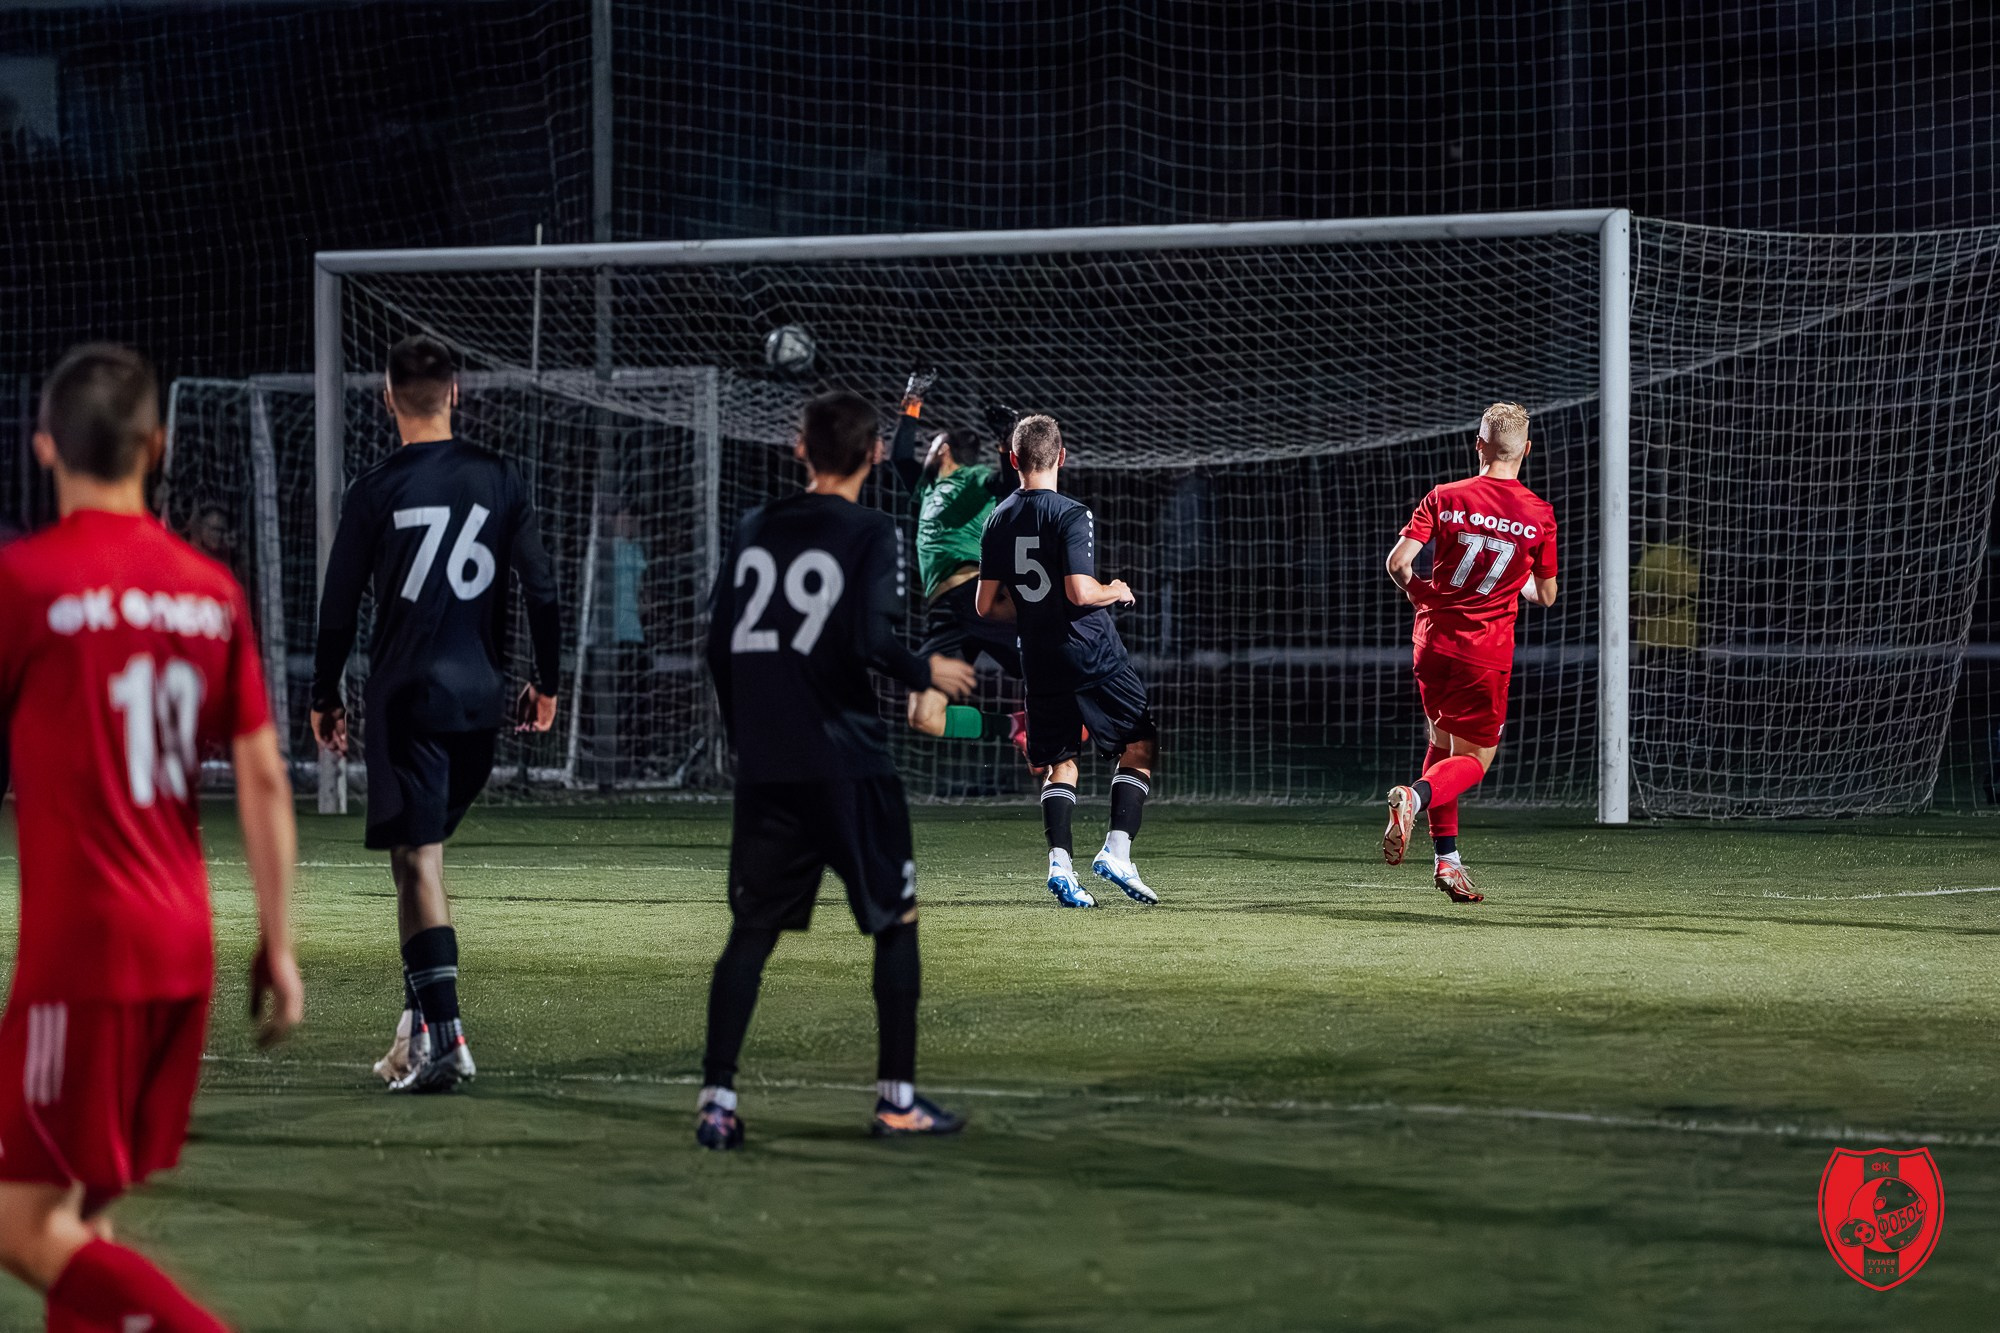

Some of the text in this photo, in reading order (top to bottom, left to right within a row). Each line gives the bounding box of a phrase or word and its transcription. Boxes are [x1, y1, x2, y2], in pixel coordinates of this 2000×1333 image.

[393, 502, 496, 602] 76
[1439, 510, 1537, 539] ФК ФОБОС
[1014, 536, 1052, 603] 5
[1450, 531, 1517, 596] 77
[731, 546, 845, 656] 29
